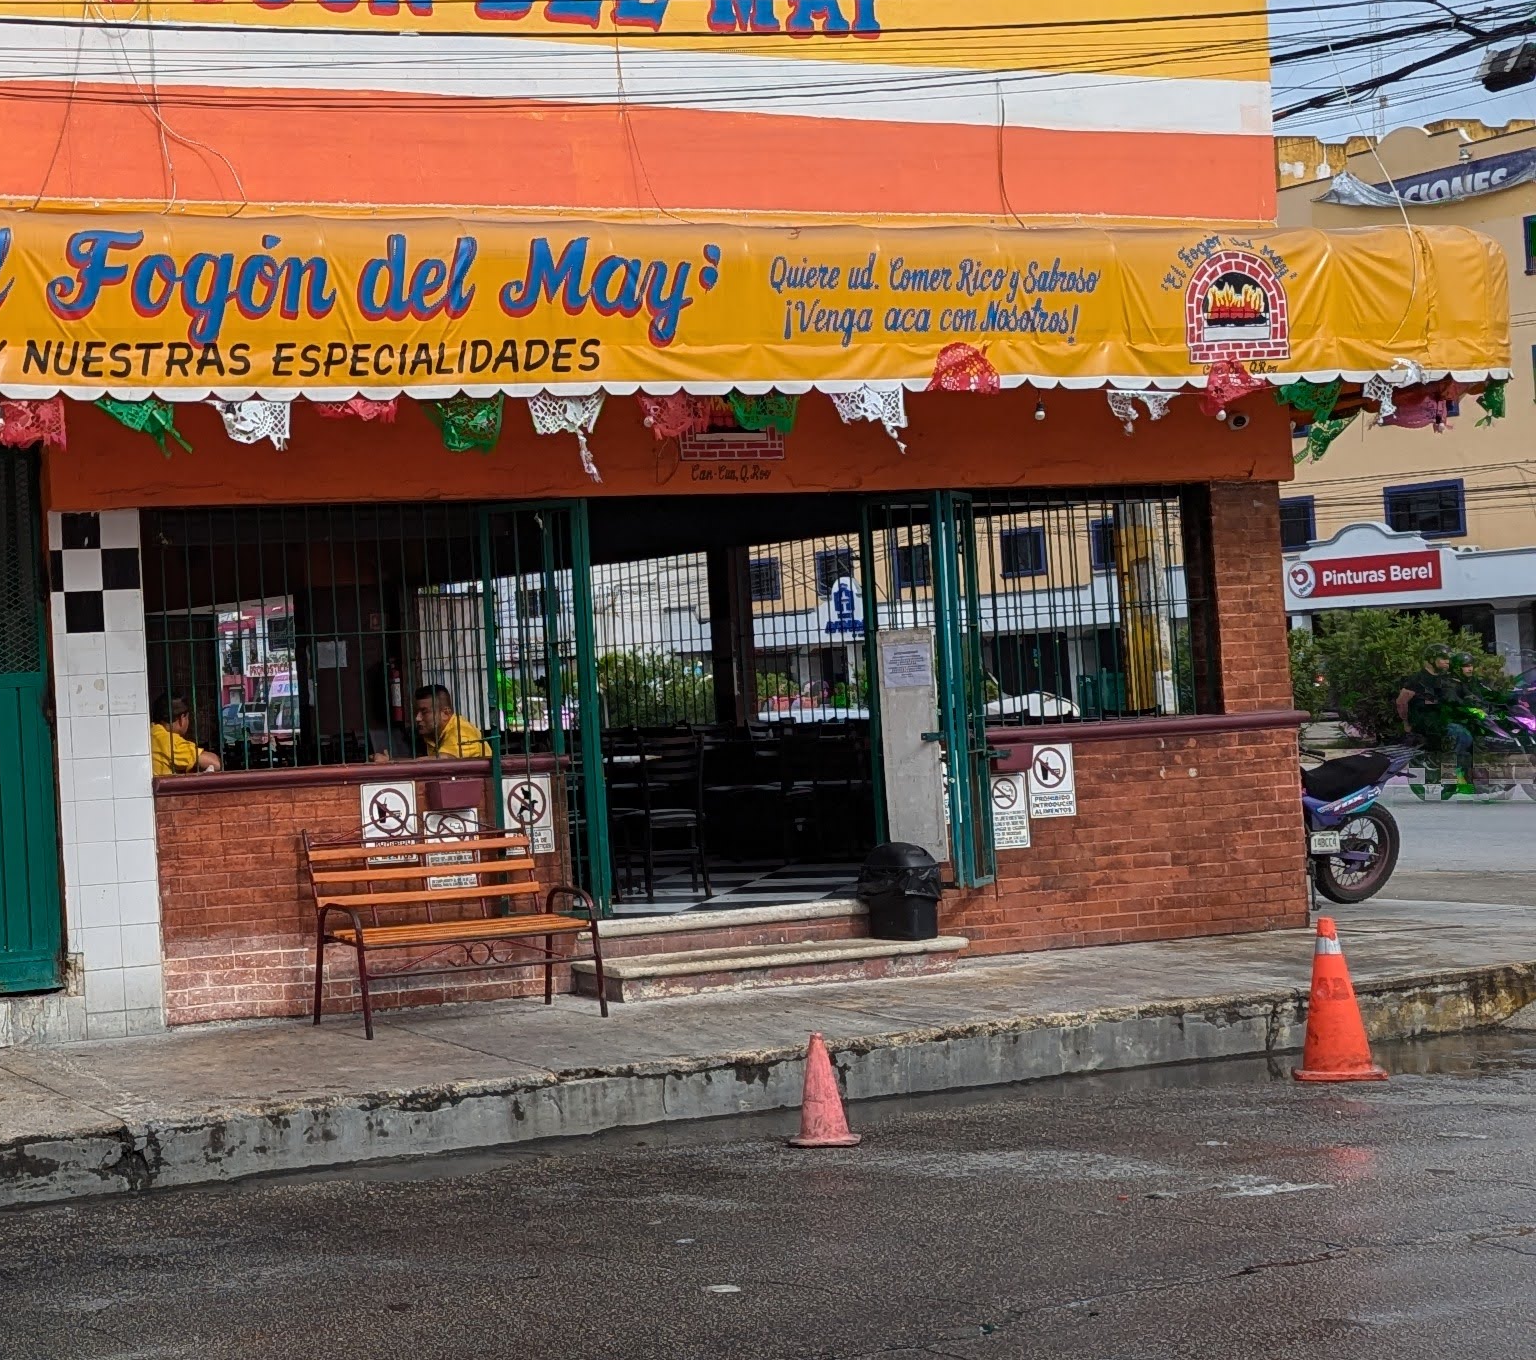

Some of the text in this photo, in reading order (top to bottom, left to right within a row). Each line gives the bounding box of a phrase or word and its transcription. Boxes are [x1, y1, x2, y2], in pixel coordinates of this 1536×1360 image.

[1389, 167, 1508, 202] CIONES
[46, 229, 337, 349] Fogón
[357, 233, 476, 322] del
[769, 252, 1100, 302] Quiere ud. Comer Rico y Sabroso
[884, 307, 931, 332] aca
[940, 307, 978, 332] con
[22, 339, 252, 378] NUESTRAS
[271, 338, 601, 378] ESPECIALIDADES
[1322, 562, 1433, 586] Pinturas Berel
